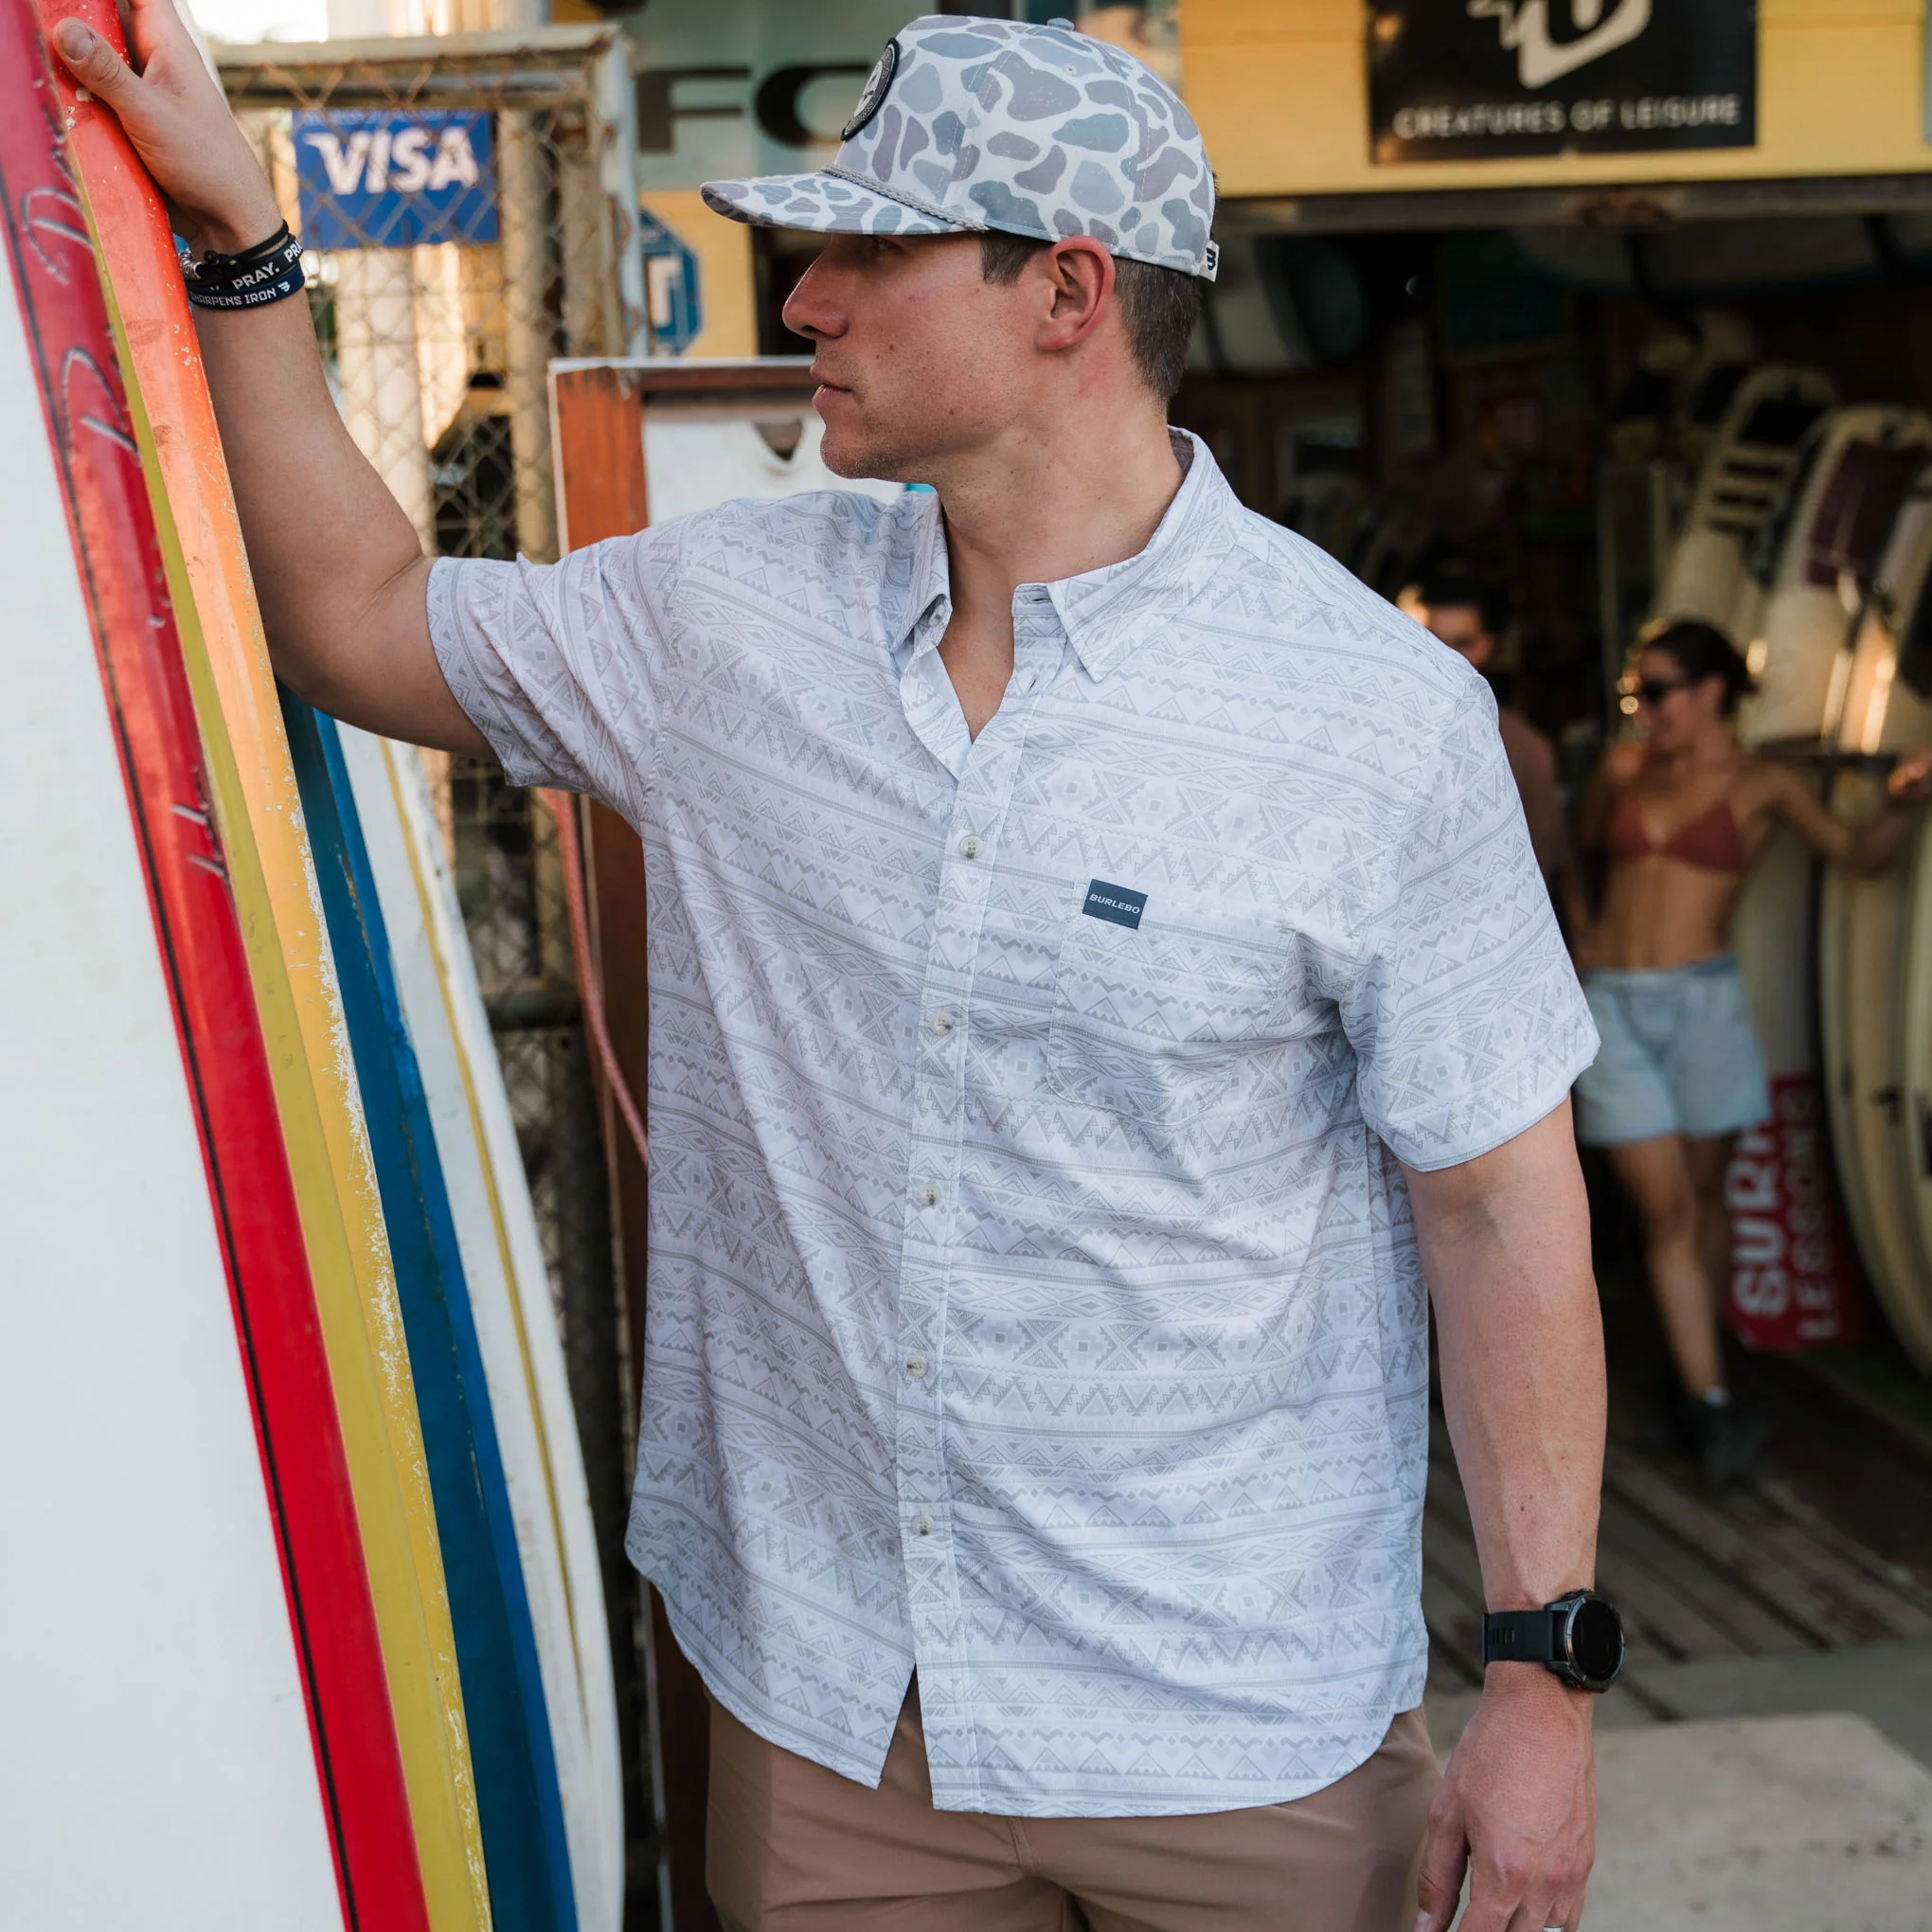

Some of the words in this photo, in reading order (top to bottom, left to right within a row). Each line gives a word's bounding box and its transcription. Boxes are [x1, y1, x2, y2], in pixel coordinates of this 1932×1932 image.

[1393, 101, 1565, 140] CREATURES
[1570, 98, 1614, 132] OF
[1620, 94, 1742, 130] LEISURE
[302, 126, 480, 195] VISA
[232, 261, 280, 290] PRAY.
[245, 287, 277, 304] IRON
[1089, 893, 1140, 914] BURLEBO
